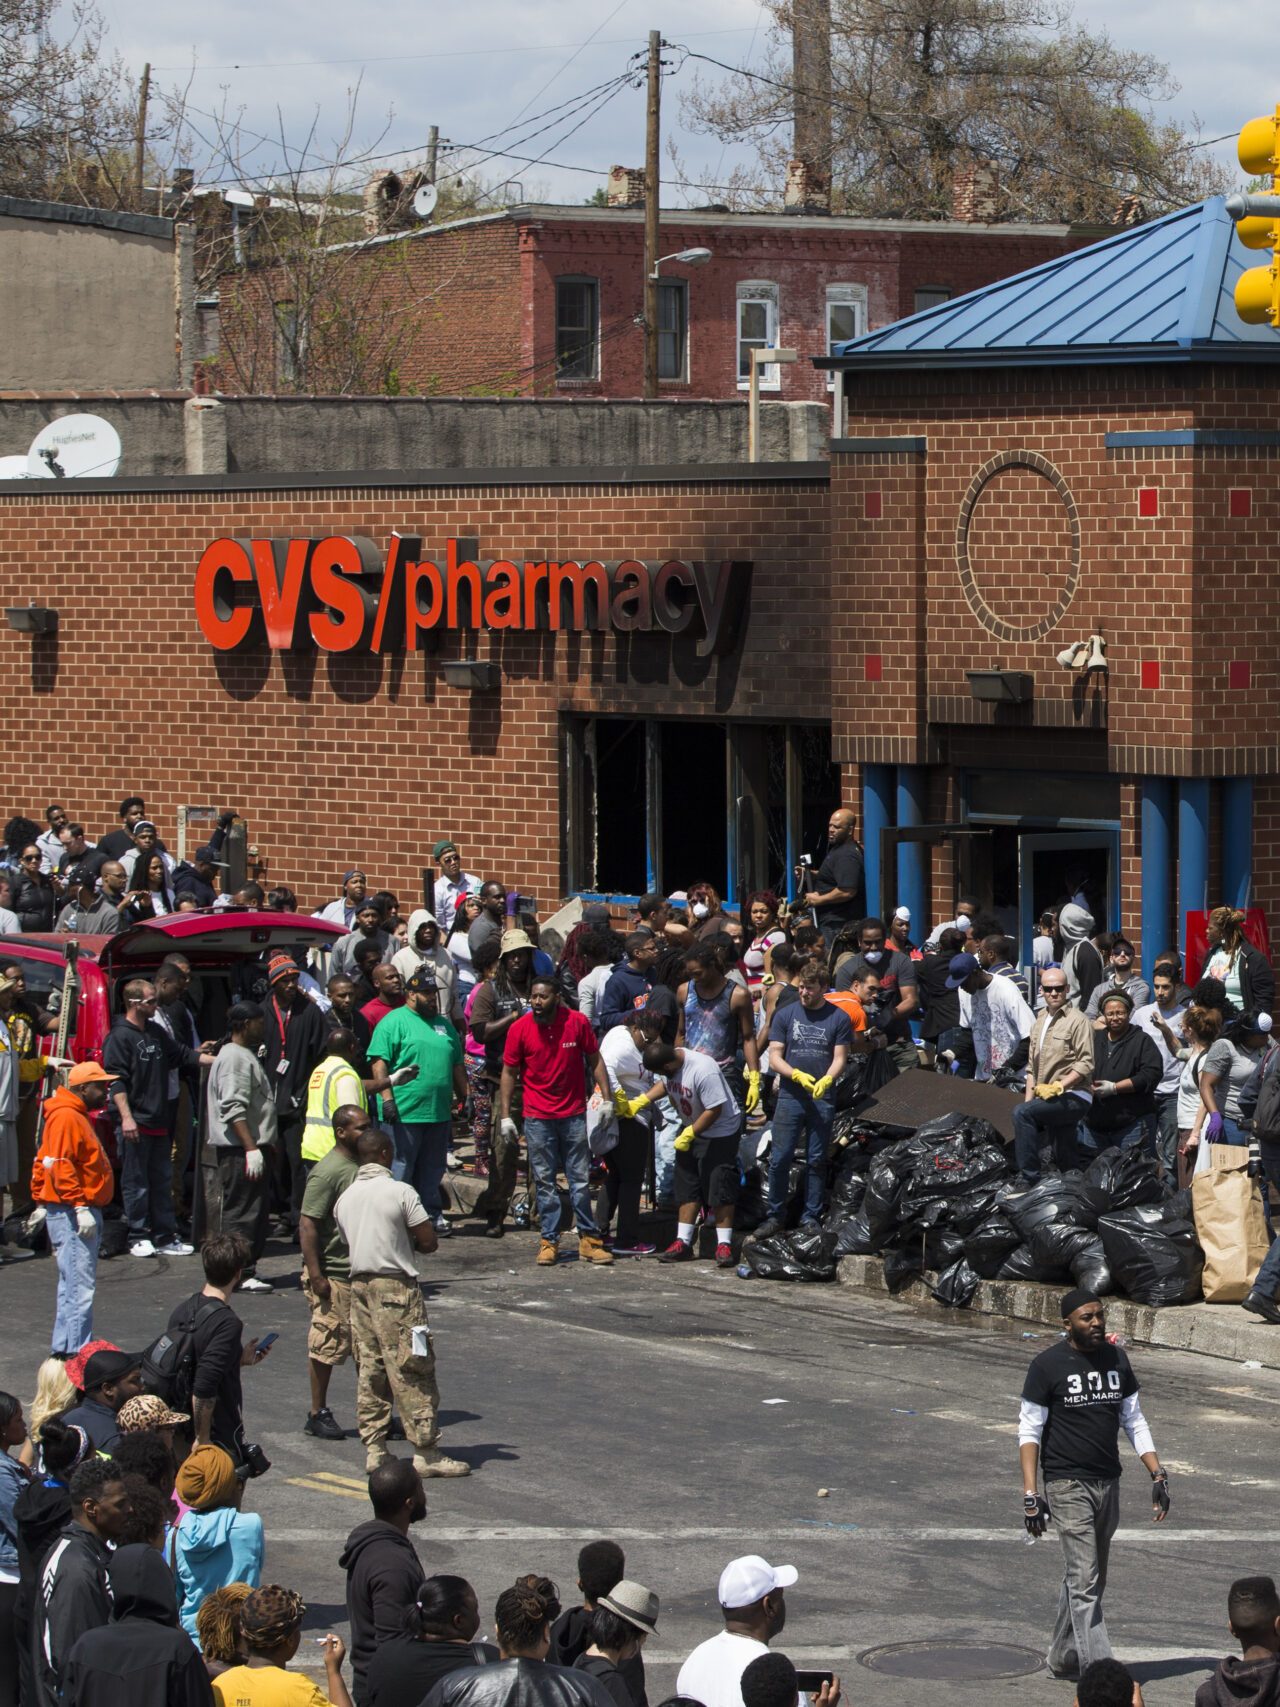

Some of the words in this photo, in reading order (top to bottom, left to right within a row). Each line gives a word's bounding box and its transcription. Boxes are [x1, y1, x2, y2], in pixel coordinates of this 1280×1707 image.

[1067, 1371, 1120, 1394] 300
[1064, 1395, 1088, 1403] MEN
[1092, 1392, 1122, 1400] MARCH
